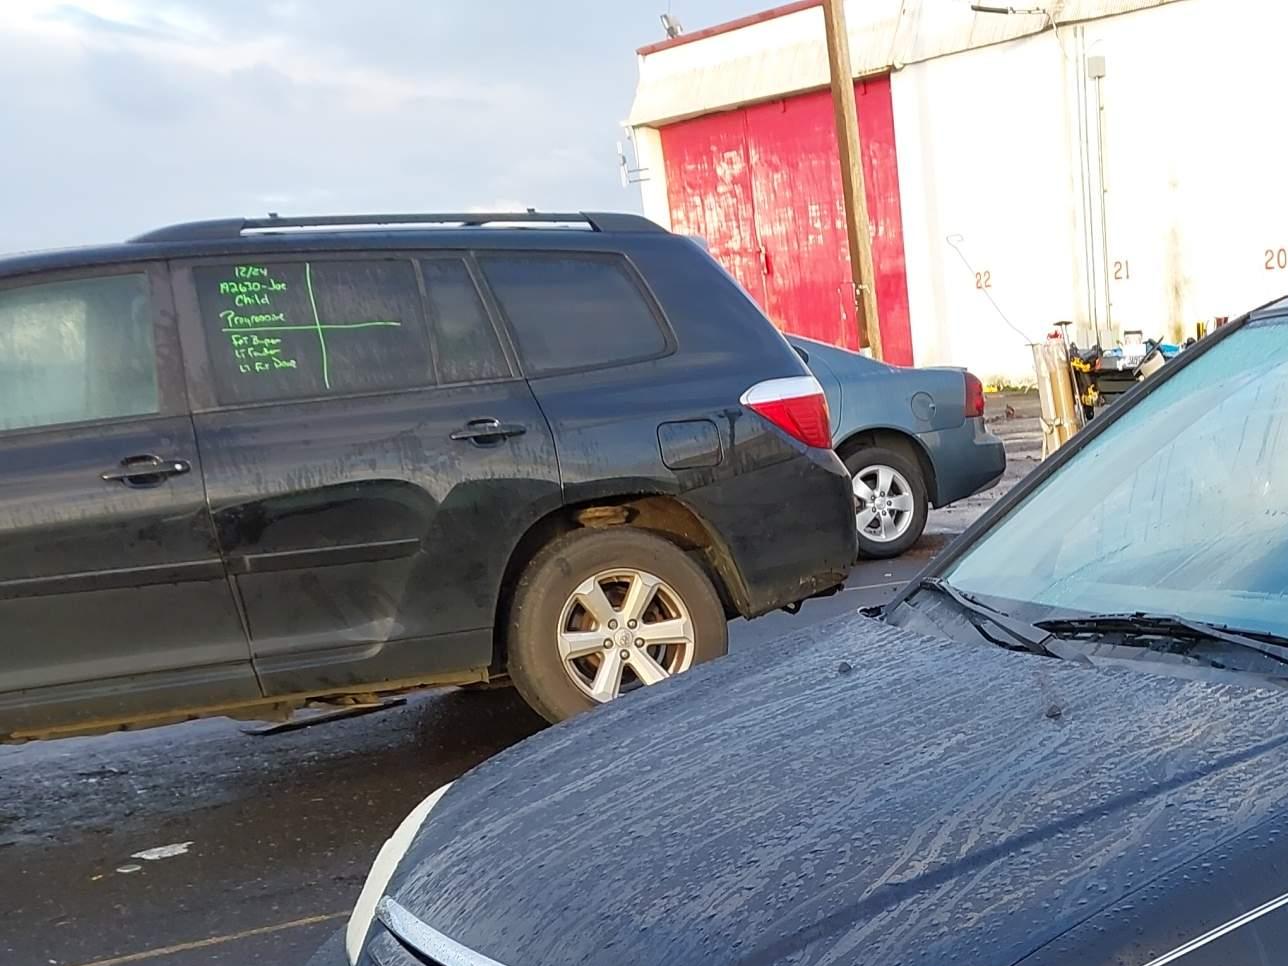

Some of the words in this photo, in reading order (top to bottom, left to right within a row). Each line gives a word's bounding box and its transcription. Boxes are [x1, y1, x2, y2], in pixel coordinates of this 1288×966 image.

[1264, 248, 1287, 270] 20
[975, 270, 992, 289] 22
[1114, 260, 1130, 280] 21
[235, 293, 270, 307] Child
